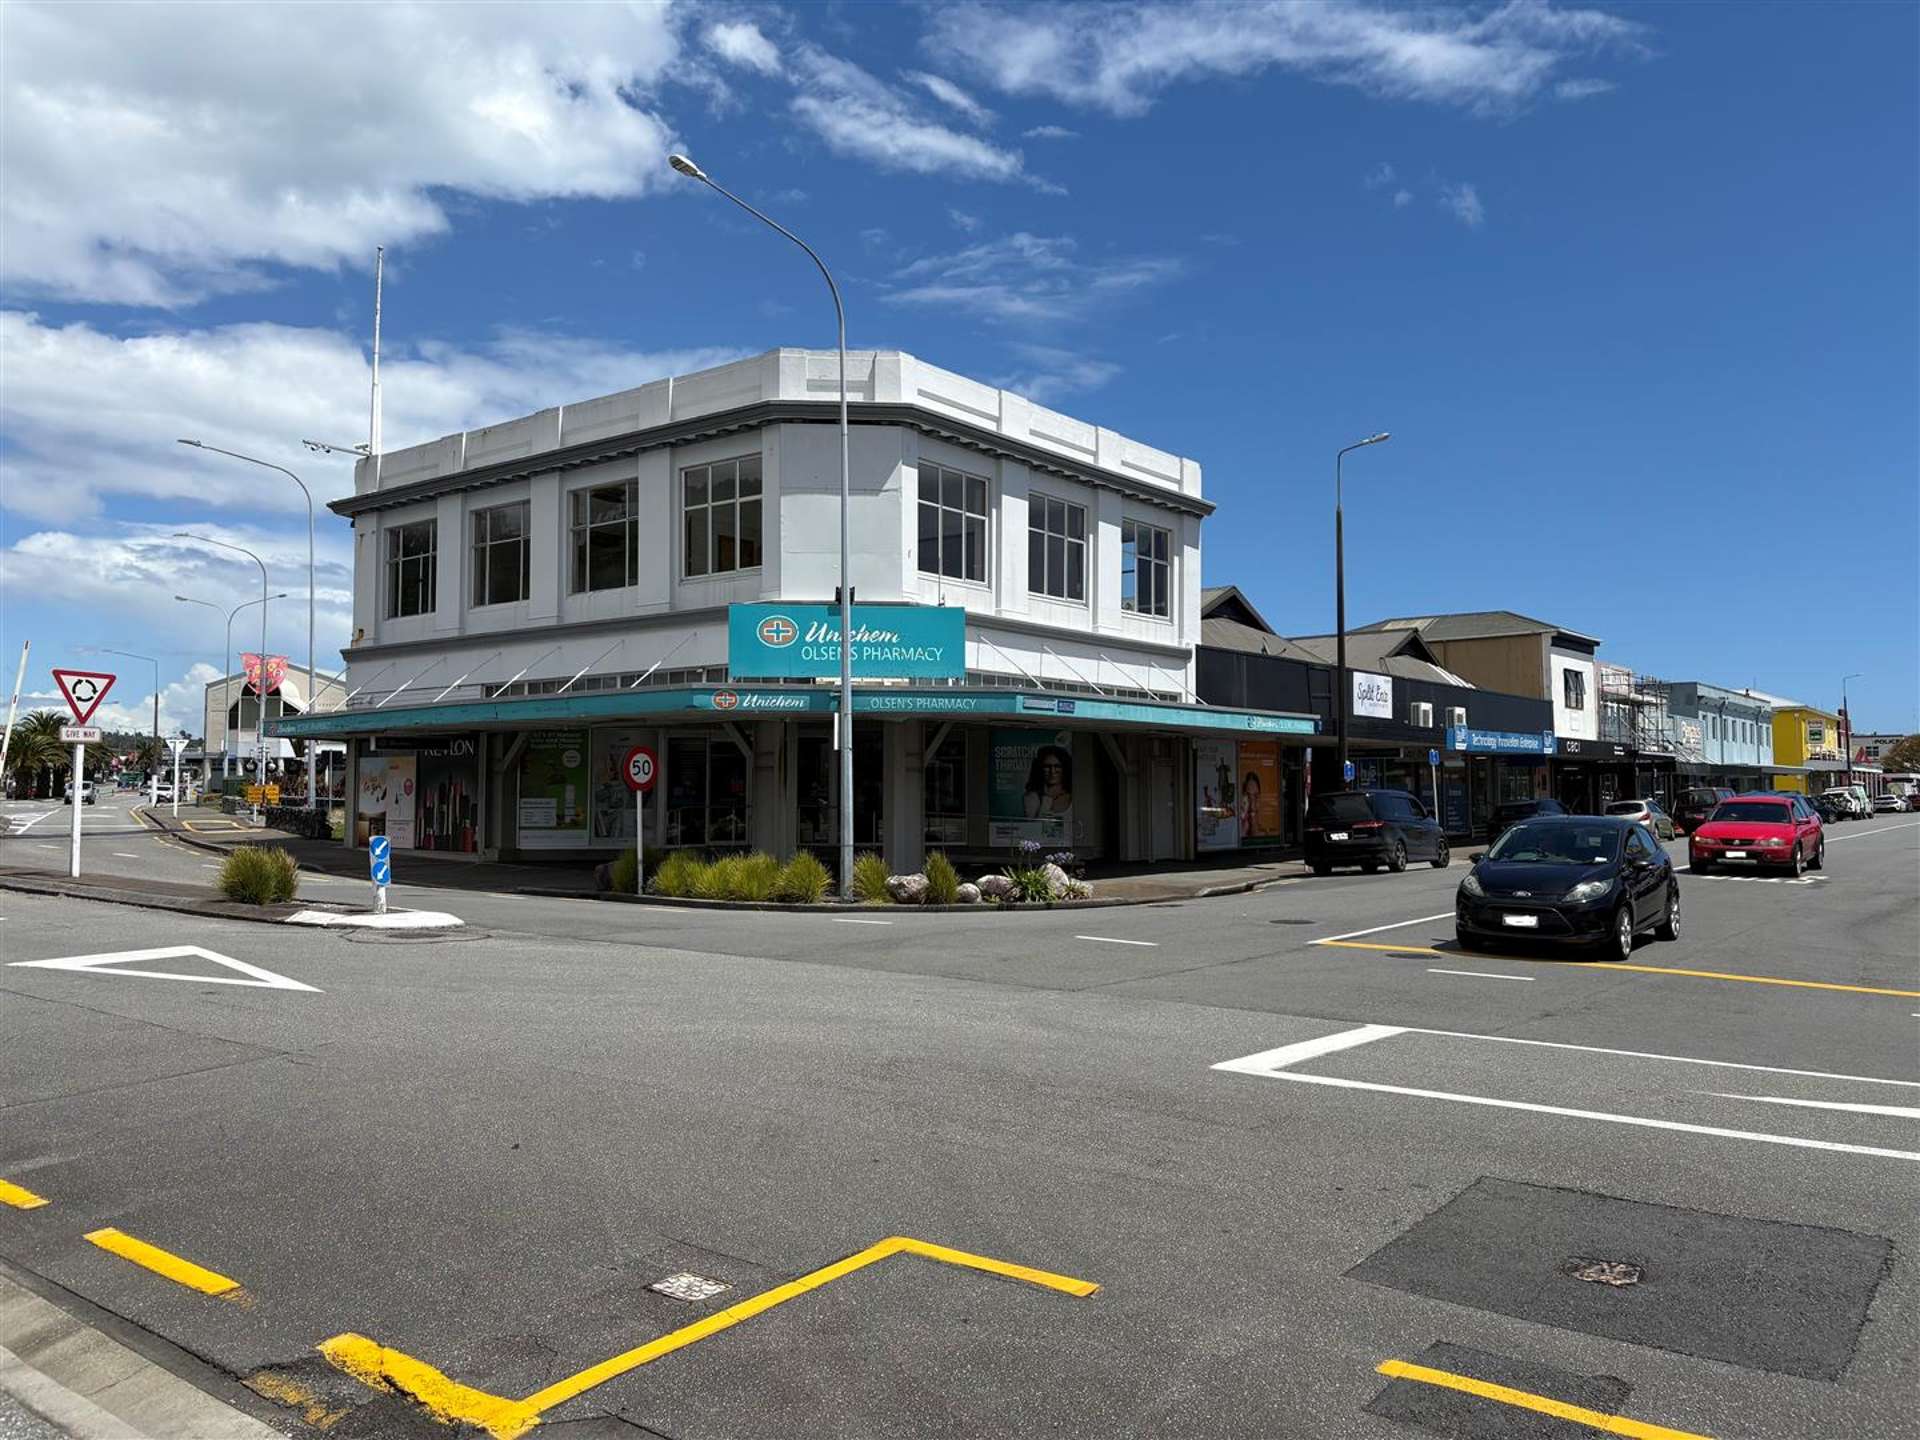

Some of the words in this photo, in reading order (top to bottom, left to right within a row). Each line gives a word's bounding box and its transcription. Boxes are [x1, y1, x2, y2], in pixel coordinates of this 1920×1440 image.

[804, 621, 901, 643] Unchem
[863, 647, 943, 661] PHARMACY
[743, 693, 806, 708] Unichem
[870, 697, 914, 709] OLSEN'S
[916, 698, 977, 710] PHARMACY
[66, 730, 80, 738] GIVE
[632, 760, 651, 776] 50
